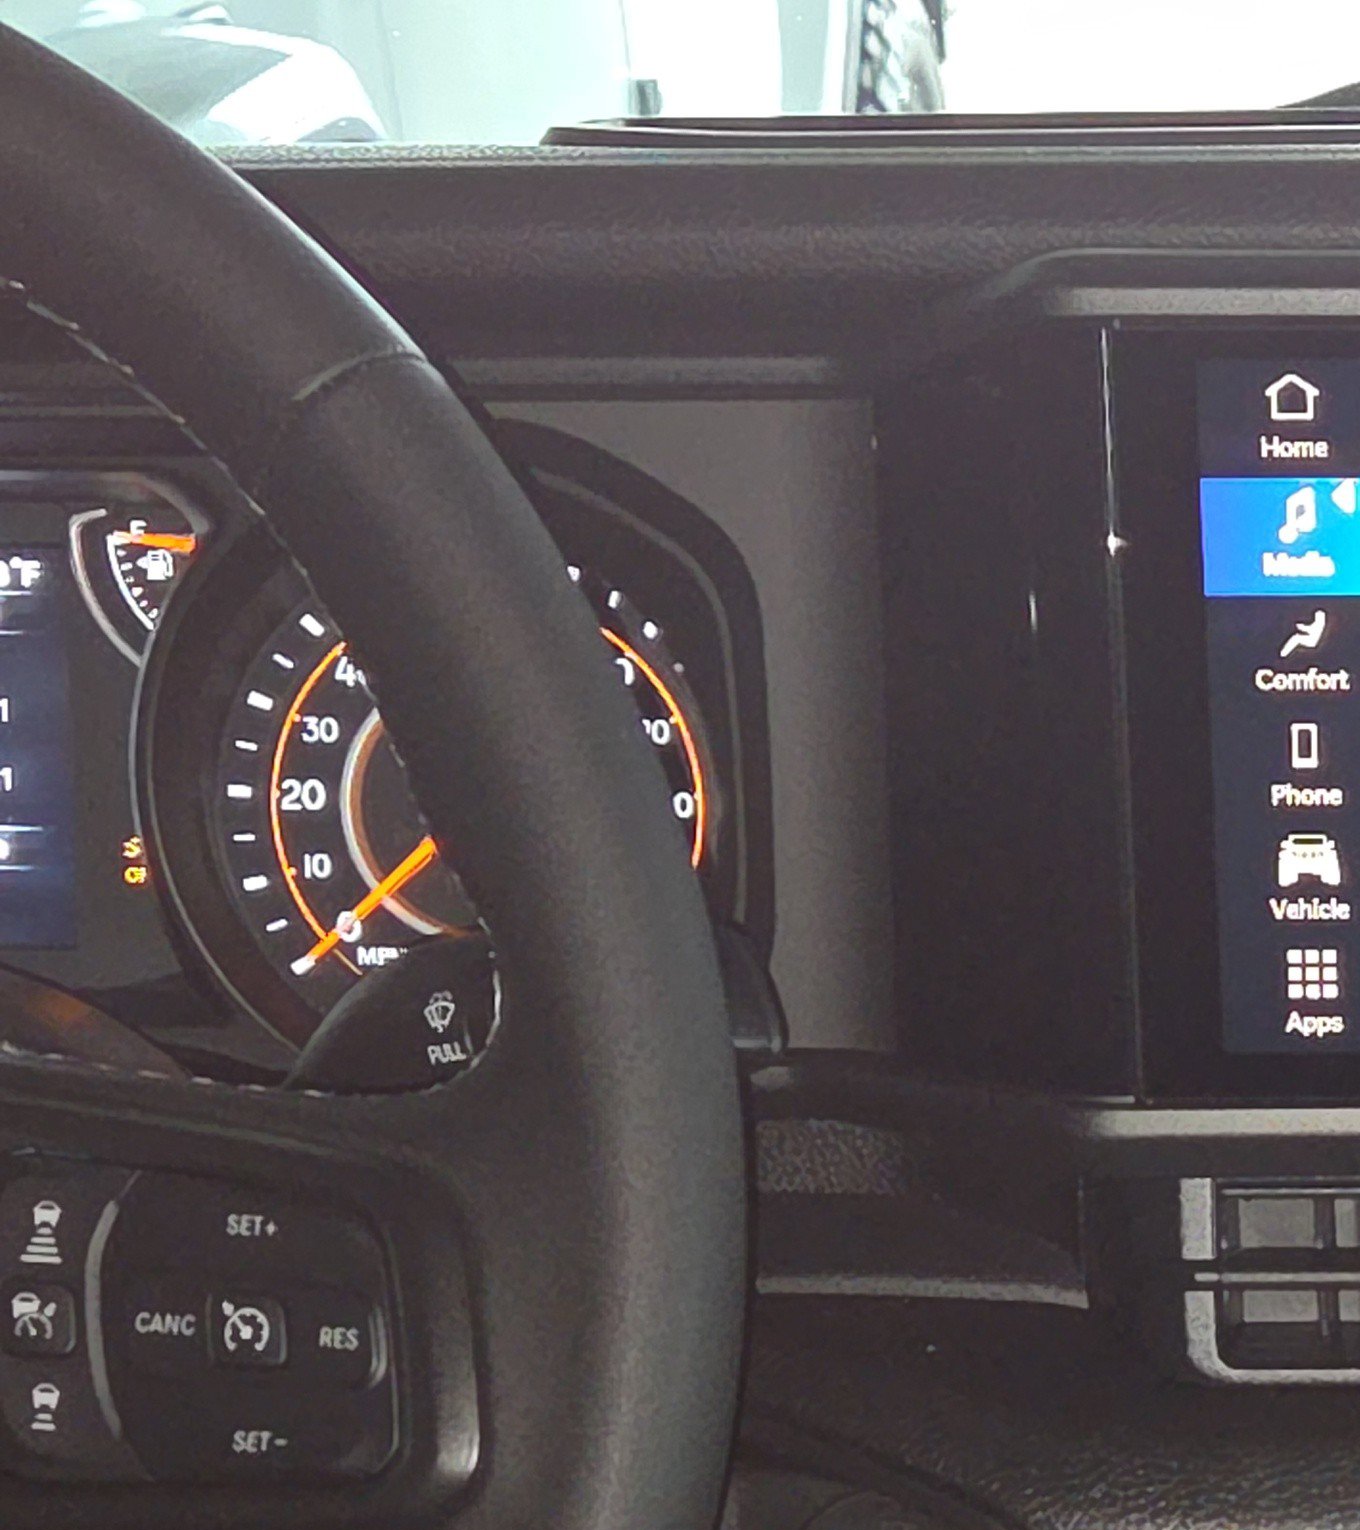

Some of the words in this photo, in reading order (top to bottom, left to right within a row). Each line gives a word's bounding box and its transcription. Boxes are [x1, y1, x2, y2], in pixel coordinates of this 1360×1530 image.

[1260, 435, 1329, 458] Home
[1255, 667, 1351, 693] Comfort
[301, 716, 340, 743] 30
[281, 778, 327, 811] 20
[1270, 783, 1343, 808] Phone
[303, 853, 332, 880] 10
[1269, 897, 1351, 922] Vehicle
[1285, 1012, 1345, 1038] Apps
[427, 1041, 467, 1066] PULL
[226, 1215, 279, 1237] SET+
[135, 1312, 197, 1337] CANC
[319, 1327, 359, 1351] RES
